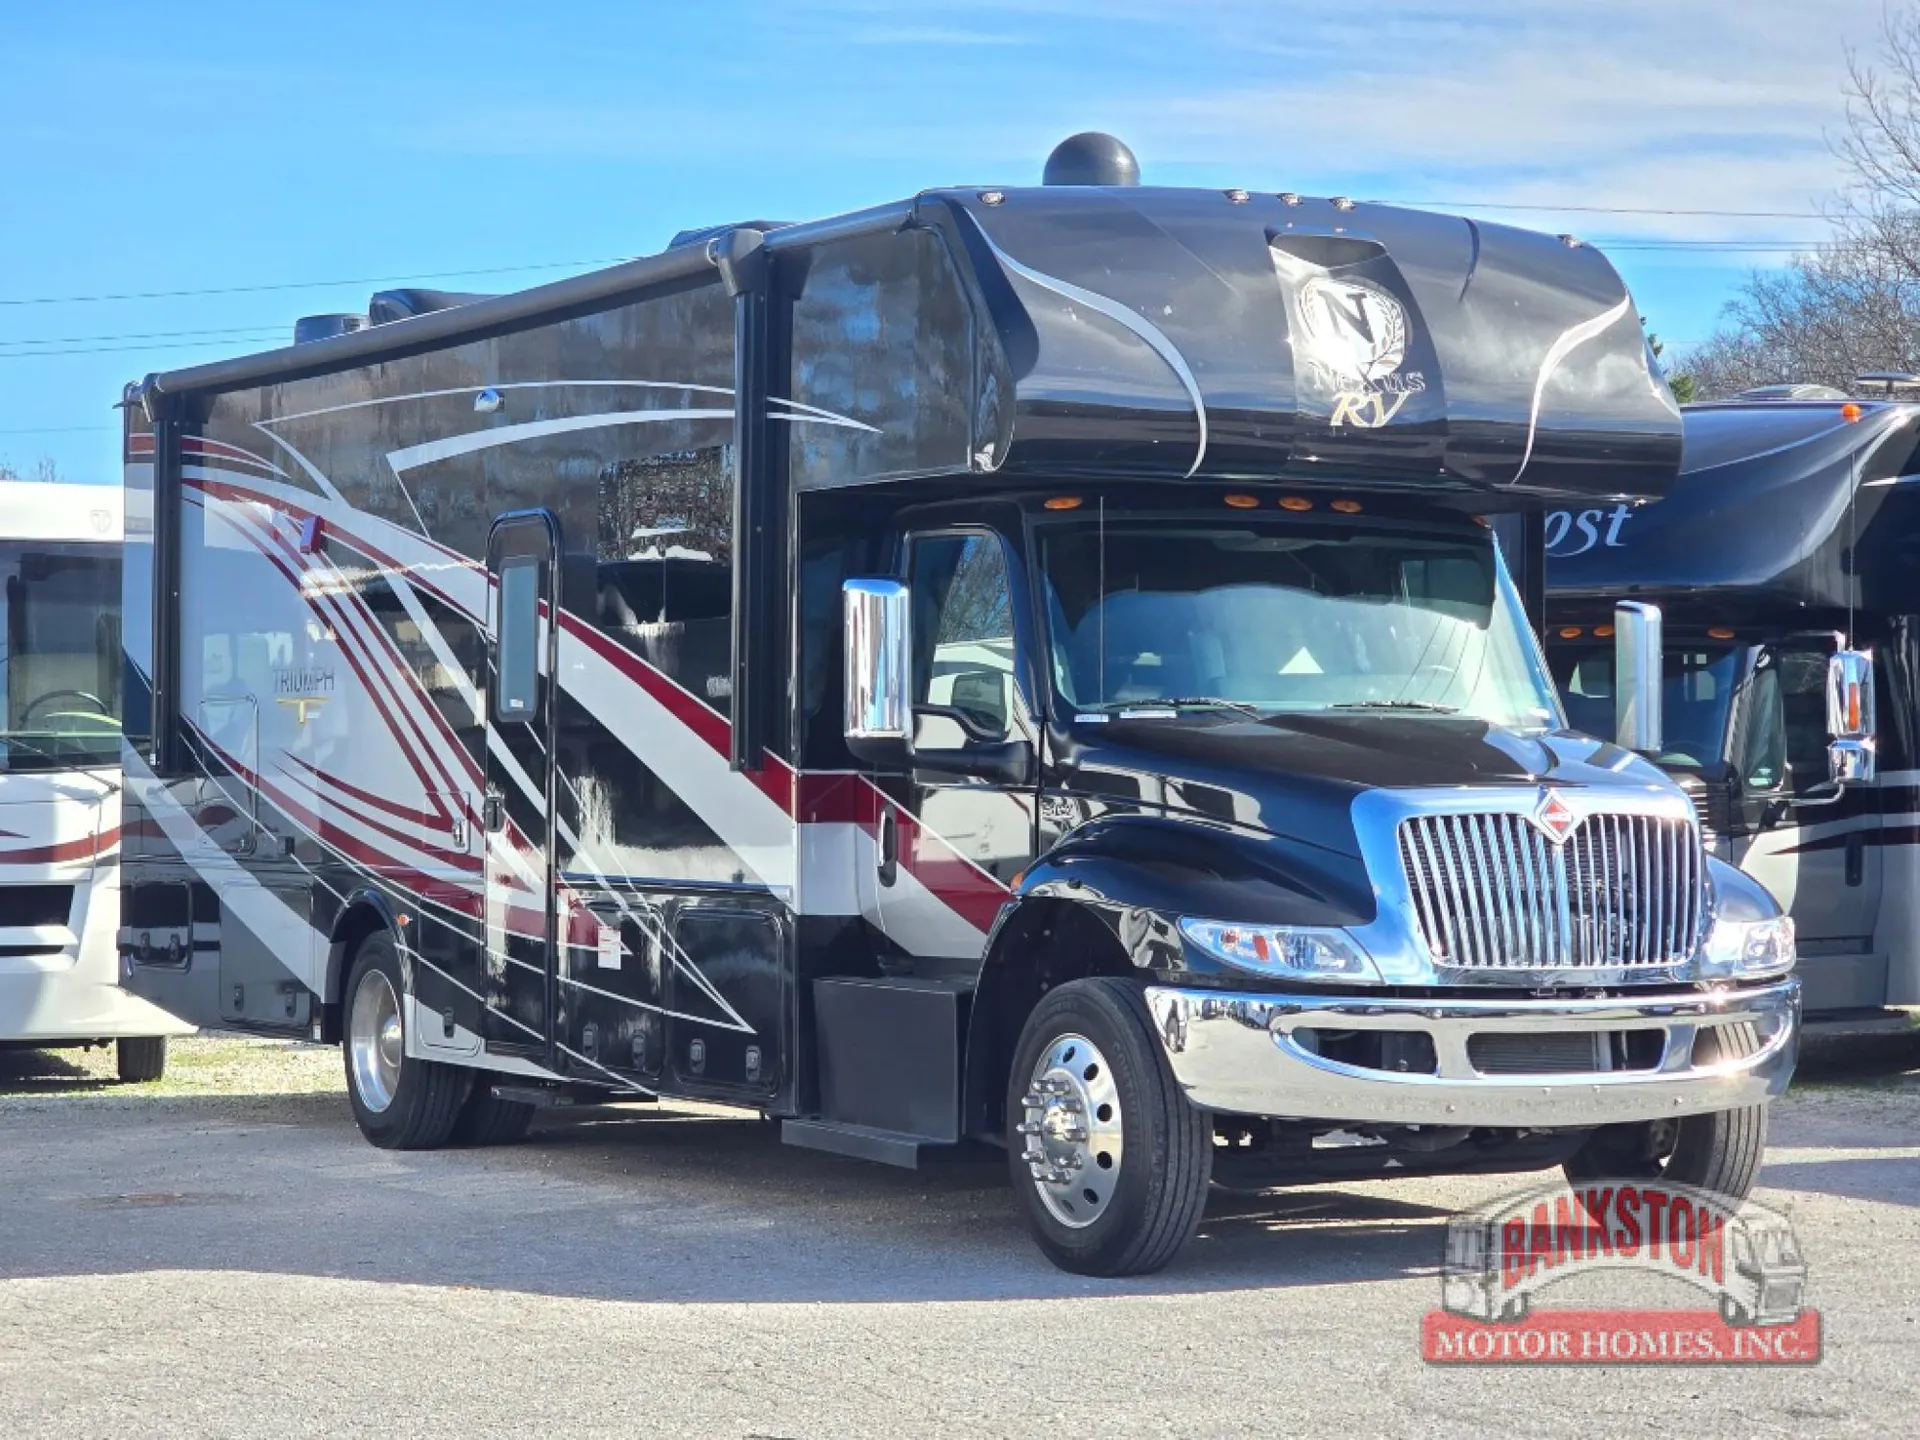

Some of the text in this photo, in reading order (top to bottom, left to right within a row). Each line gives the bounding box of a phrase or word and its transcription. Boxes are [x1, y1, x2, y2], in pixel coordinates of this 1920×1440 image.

[1329, 390, 1413, 428] RV
[1544, 503, 1633, 557] ost
[272, 667, 336, 693] TRIUMPH
